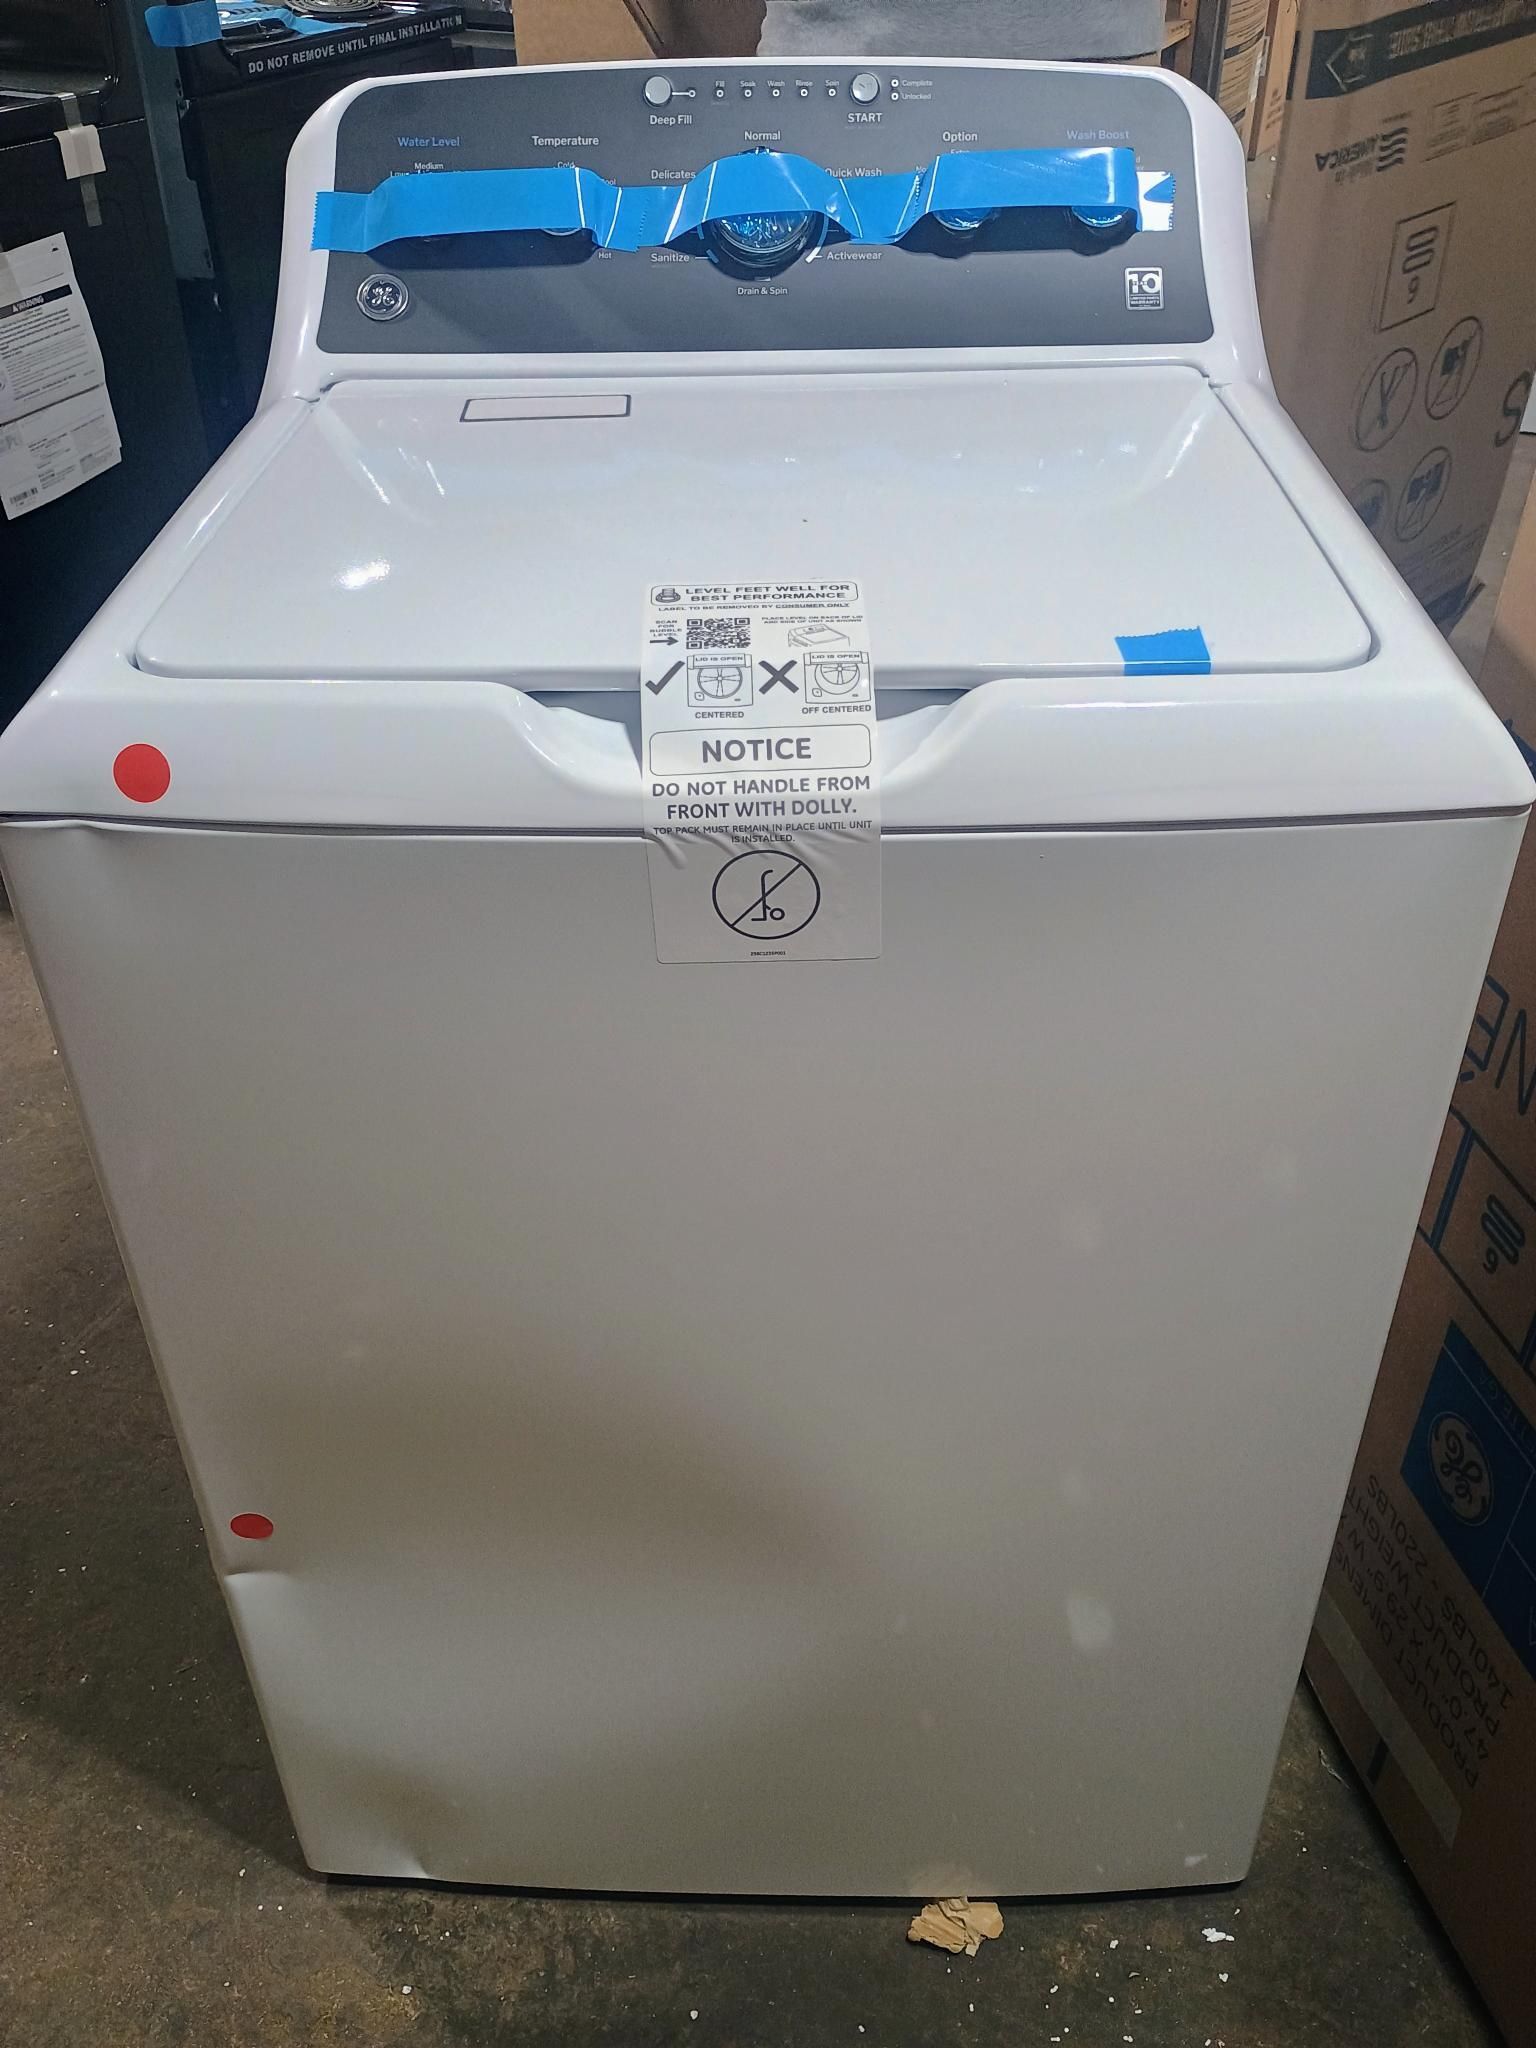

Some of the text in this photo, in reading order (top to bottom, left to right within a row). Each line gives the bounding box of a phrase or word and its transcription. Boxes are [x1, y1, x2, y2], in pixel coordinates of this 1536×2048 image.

[248, 60, 265, 74] DO
[267, 53, 289, 70] NOT
[292, 46, 335, 64] REMOVE
[338, 40, 368, 55] UNTIL
[369, 32, 397, 47] FINAL
[740, 80, 756, 88] Soak
[767, 80, 785, 88] Wash
[901, 79, 933, 88] Complete
[901, 92, 932, 100] Unlocked
[649, 114, 692, 126] Deep Fill
[847, 112, 883, 123] START
[744, 130, 781, 141] Normal
[942, 131, 978, 143] Option
[1066, 129, 1130, 140] Wash Boost
[397, 135, 460, 147] Water Level
[531, 135, 600, 148] Temperature
[414, 161, 444, 170] Medium
[650, 169, 696, 180] Delicates
[824, 167, 882, 178] Quick Wash
[598, 252, 612, 260] Hot
[650, 252, 691, 263] Sanitize
[826, 250, 883, 261] Activewear
[737, 286, 788, 297] Drain & Spin
[733, 592, 846, 600] PERFORMANCE
[694, 711, 745, 719] CENTERED
[801, 704, 872, 715] OFF CENTERED
[702, 737, 812, 763] NOTICE
[652, 775, 870, 797] DO NOT HANDLE FROM
[667, 797, 857, 820] FRONT WITH DOLLY.
[653, 820, 873, 835] TOP PACK MUST REMAIN IN PLACE UNTIL UNIT
[731, 834, 796, 843] IS INSTALLED.
[1366, 1473, 1428, 1577] 220LBS
[1347, 1529, 1365, 1562] W
[1440, 1596, 1513, 1710] 140LBS
[1410, 1595, 1500, 1737] PRODUCT
[1424, 1655, 1440, 1686] H
[1394, 1650, 1479, 1789] PRODUCT
